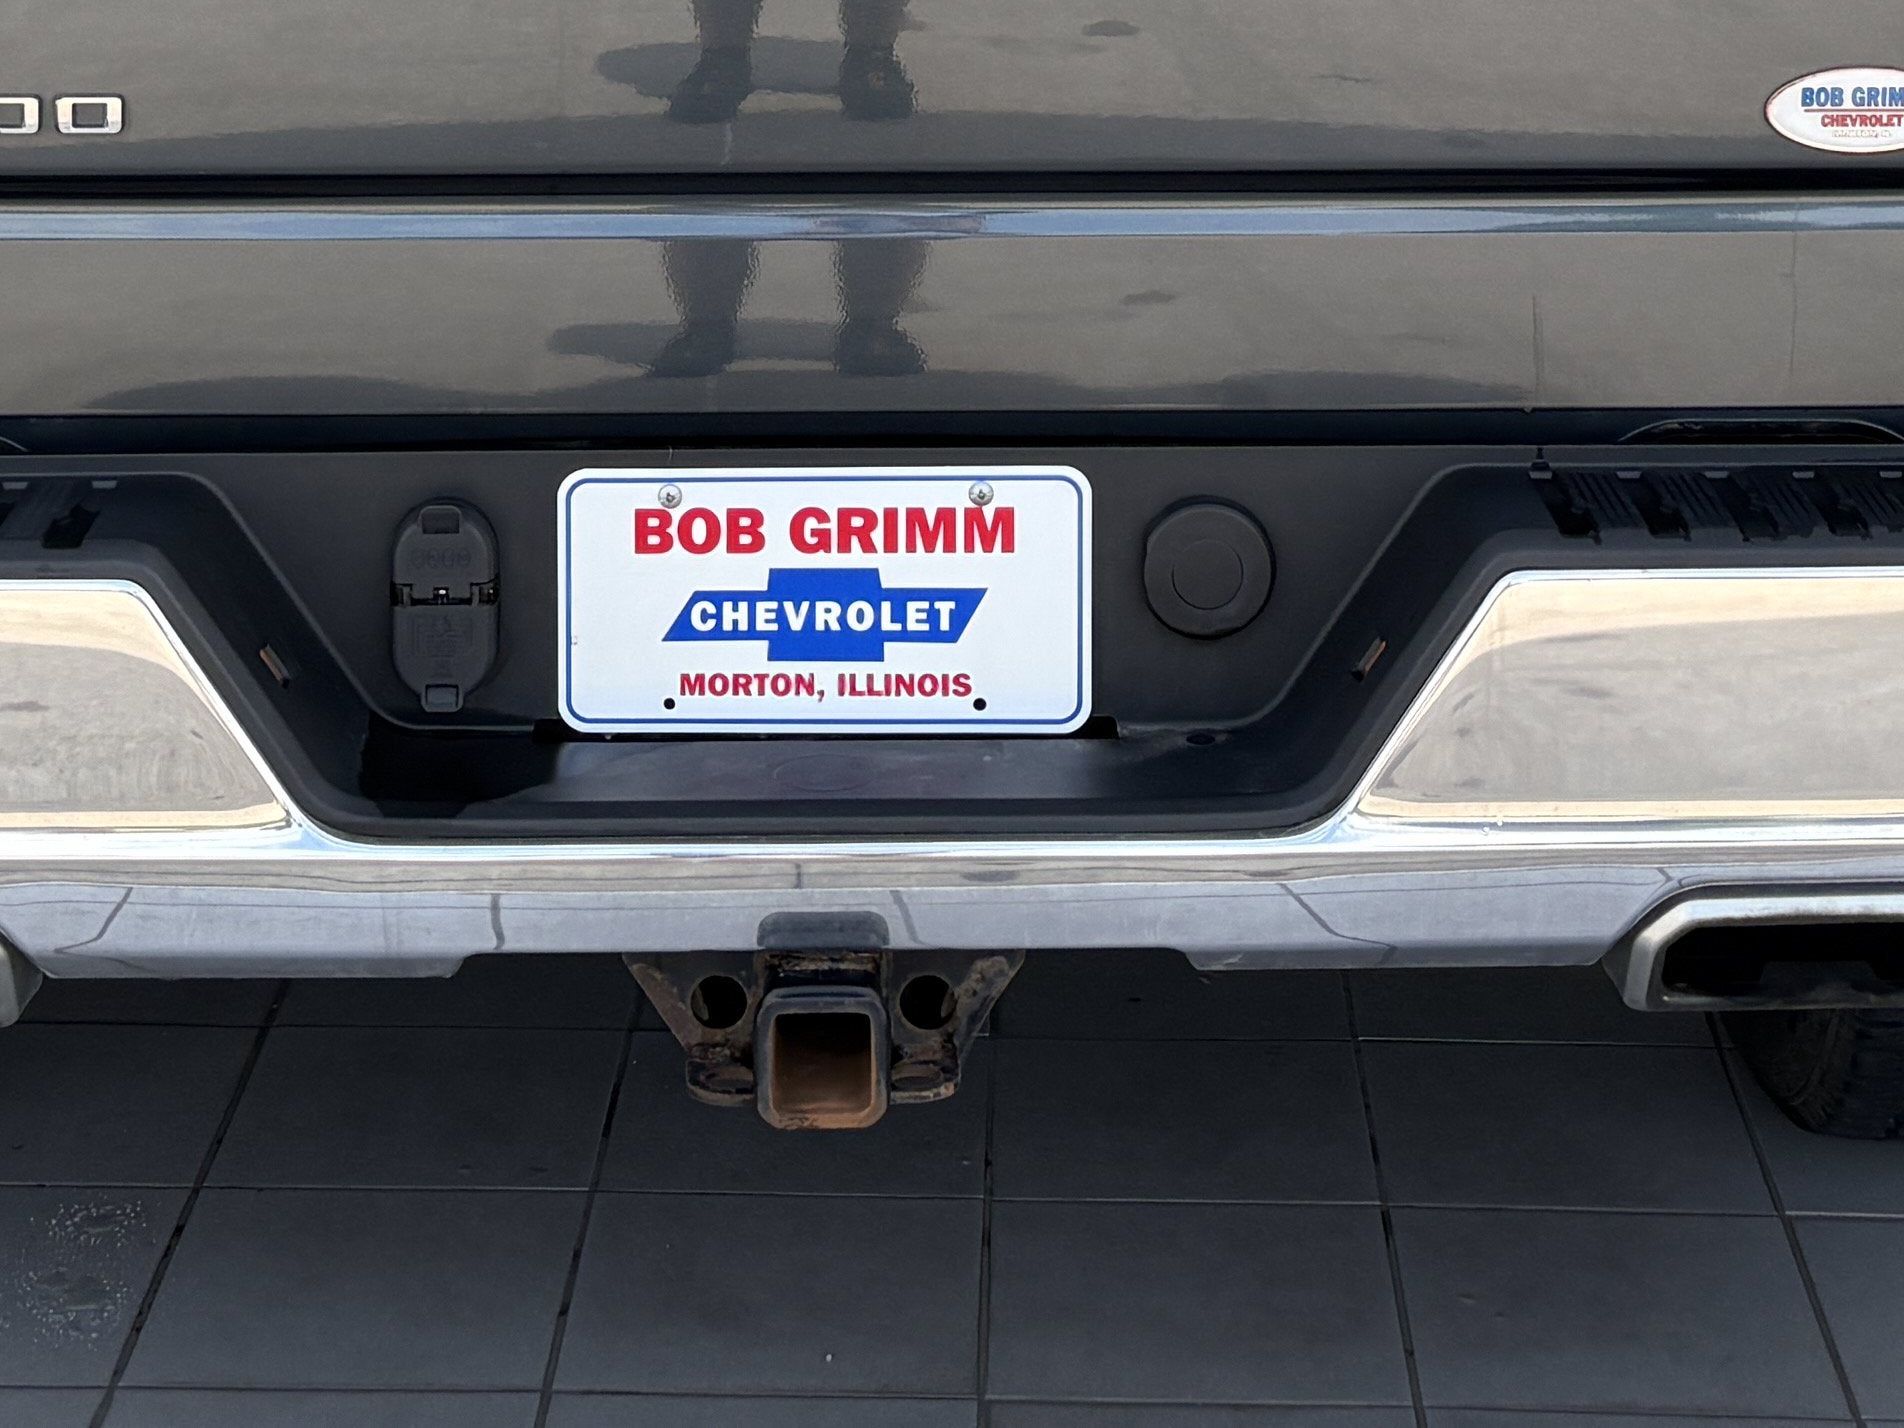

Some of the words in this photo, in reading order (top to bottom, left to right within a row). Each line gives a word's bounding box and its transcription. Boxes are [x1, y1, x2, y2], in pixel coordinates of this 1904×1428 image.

[1801, 87, 1844, 108] BOB
[1821, 114, 1904, 128] CHEVROLET
[634, 507, 766, 555] BOB
[789, 505, 1016, 555] GRIMM
[689, 600, 957, 632] CHEVROLET
[678, 672, 825, 703] MORTON,
[837, 672, 973, 697] ILLINOIS
